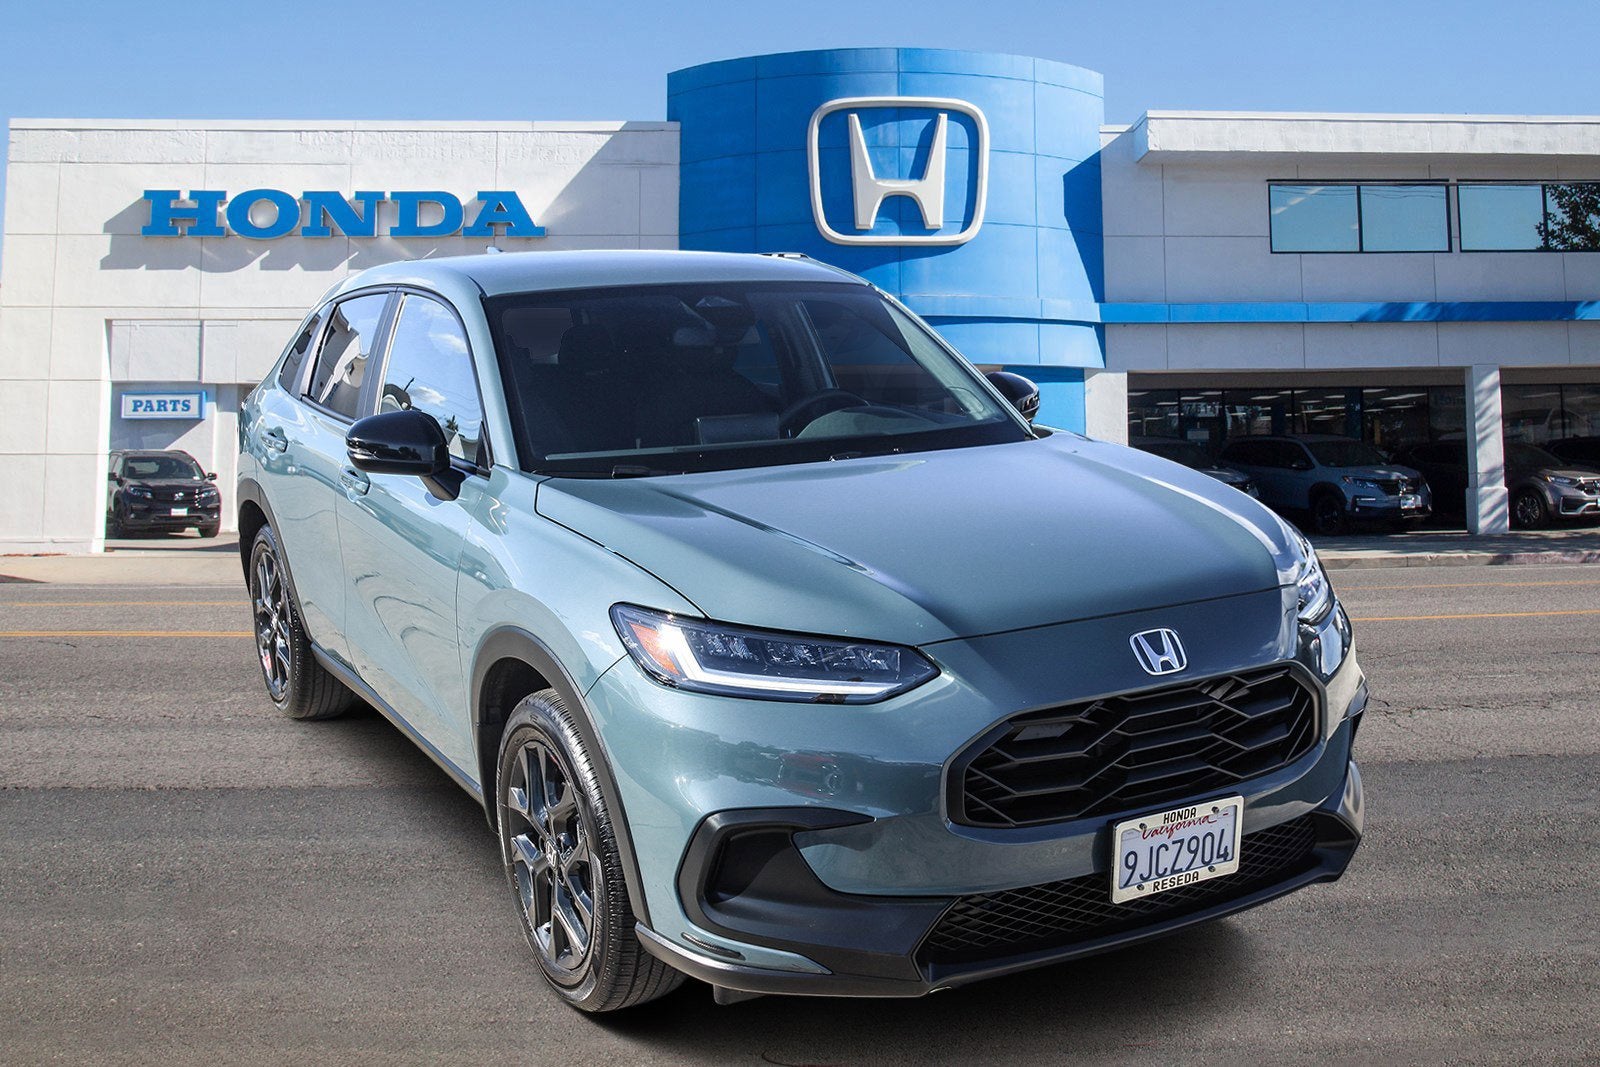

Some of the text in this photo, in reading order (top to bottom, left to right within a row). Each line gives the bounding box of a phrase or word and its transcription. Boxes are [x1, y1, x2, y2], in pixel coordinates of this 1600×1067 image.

[142, 189, 546, 239] HONDA
[131, 399, 191, 412] PARTS
[1163, 806, 1197, 824] HONDA
[1124, 828, 1229, 887] 9JCZ904
[1152, 871, 1199, 892] RESEDA
